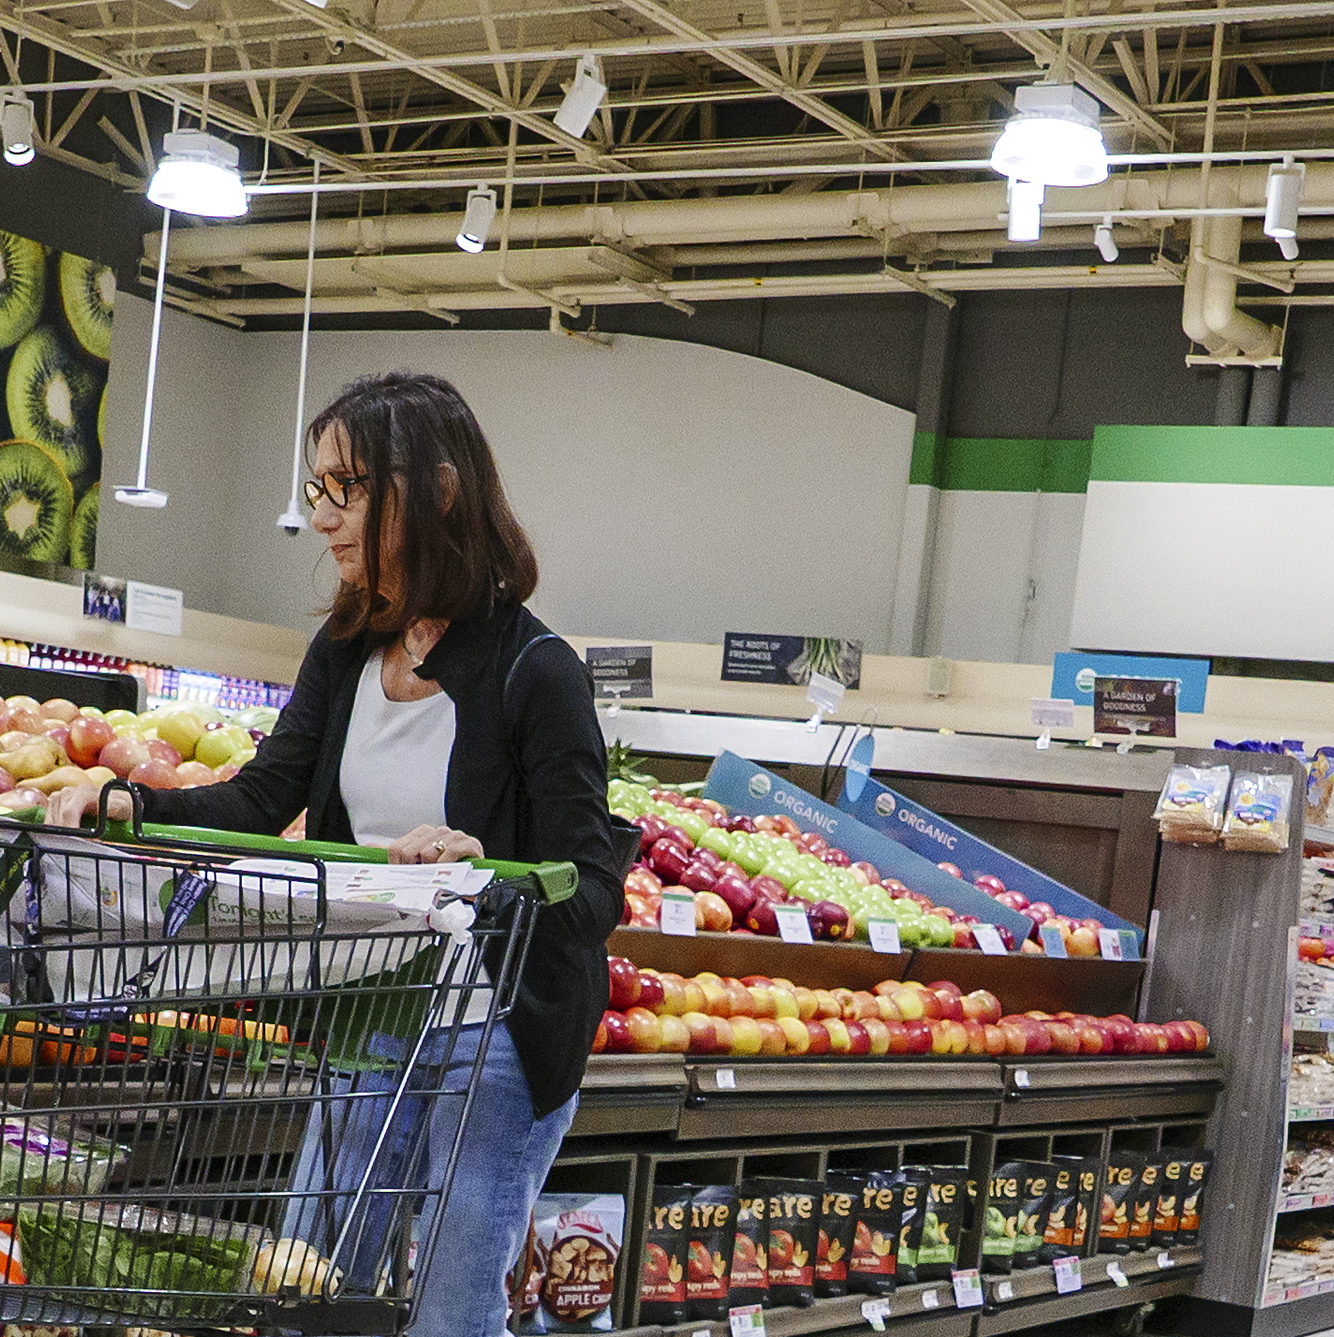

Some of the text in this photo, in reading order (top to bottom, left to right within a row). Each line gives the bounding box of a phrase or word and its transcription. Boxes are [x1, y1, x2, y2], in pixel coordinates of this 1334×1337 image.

[1102, 701, 1147, 712] GOODNESS
[773, 790, 839, 834] ORGANIC
[898, 808, 958, 851] ORGANIC
[556, 1292, 590, 1306] APPLE
